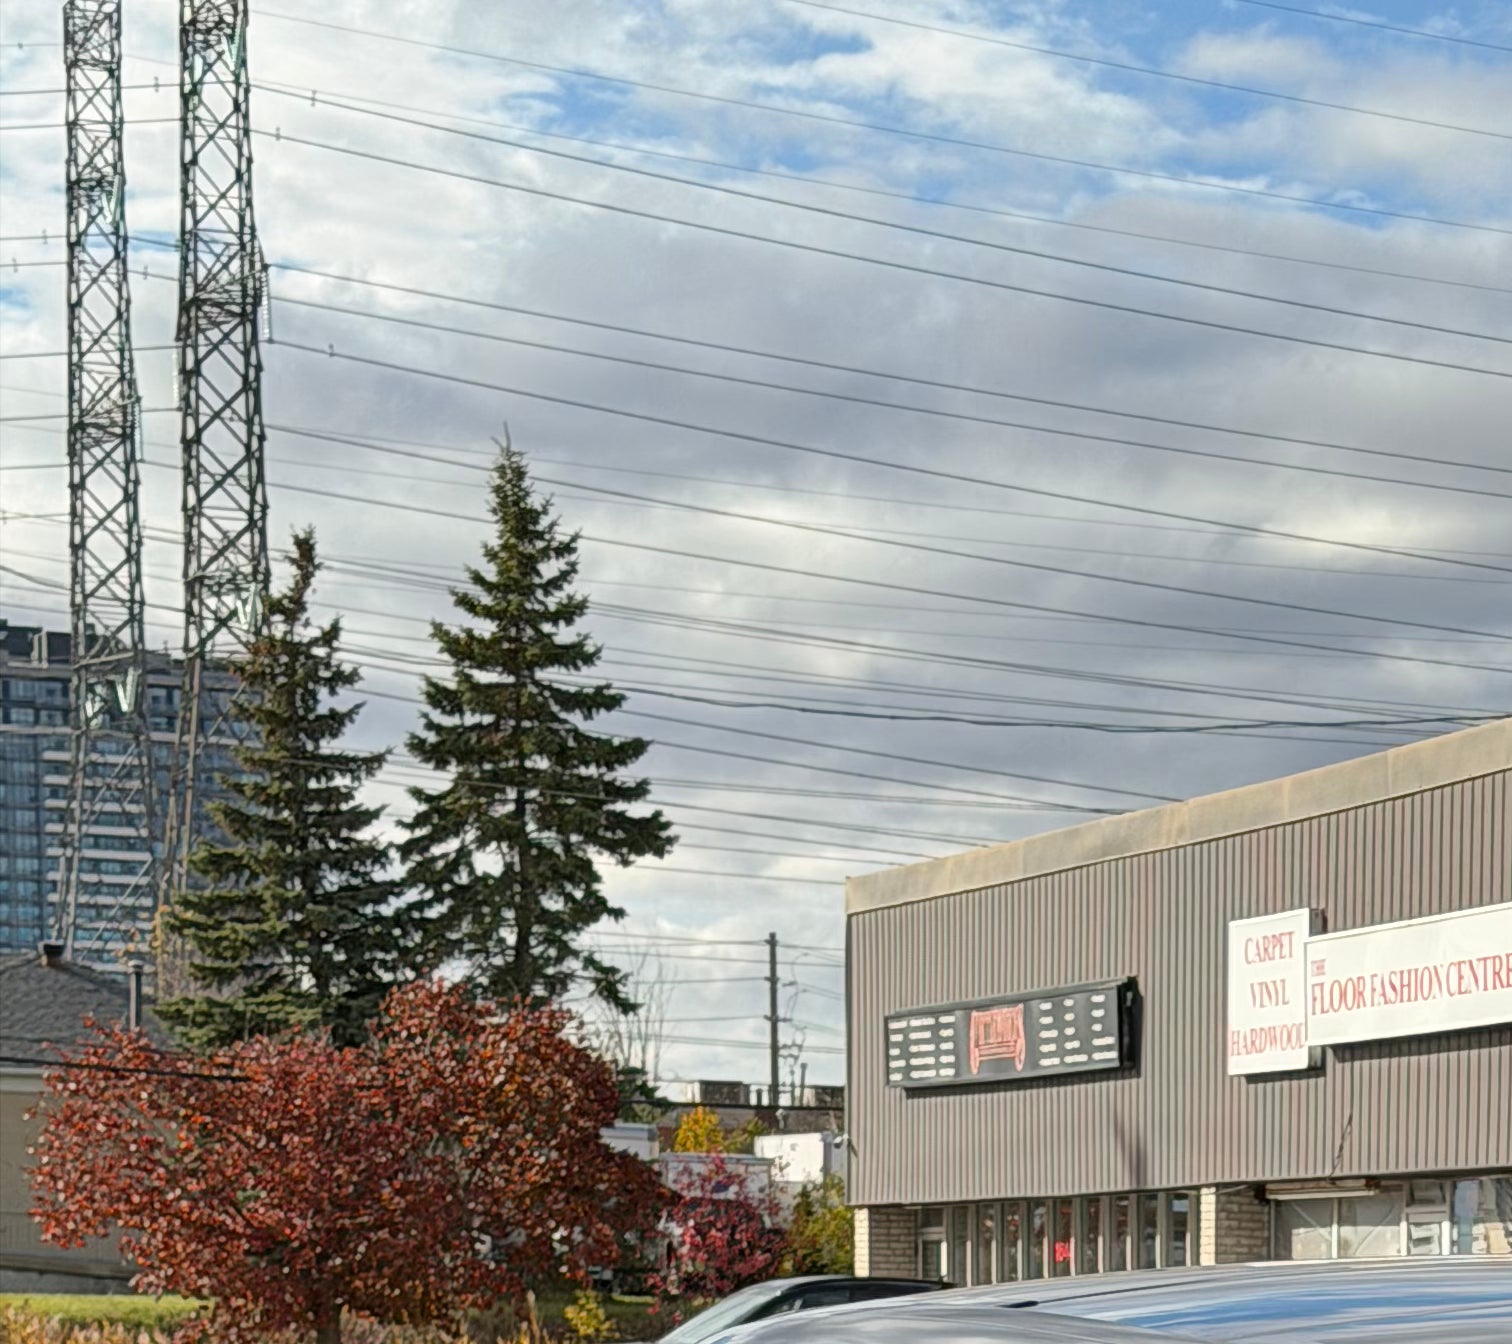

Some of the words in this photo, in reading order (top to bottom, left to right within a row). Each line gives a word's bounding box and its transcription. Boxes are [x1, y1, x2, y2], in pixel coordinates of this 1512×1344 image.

[1244, 931, 1295, 965] CARPET
[1250, 979, 1290, 1008] VINYL
[1311, 975, 1368, 1015] FLOOR
[1370, 964, 1444, 1007] FASHION
